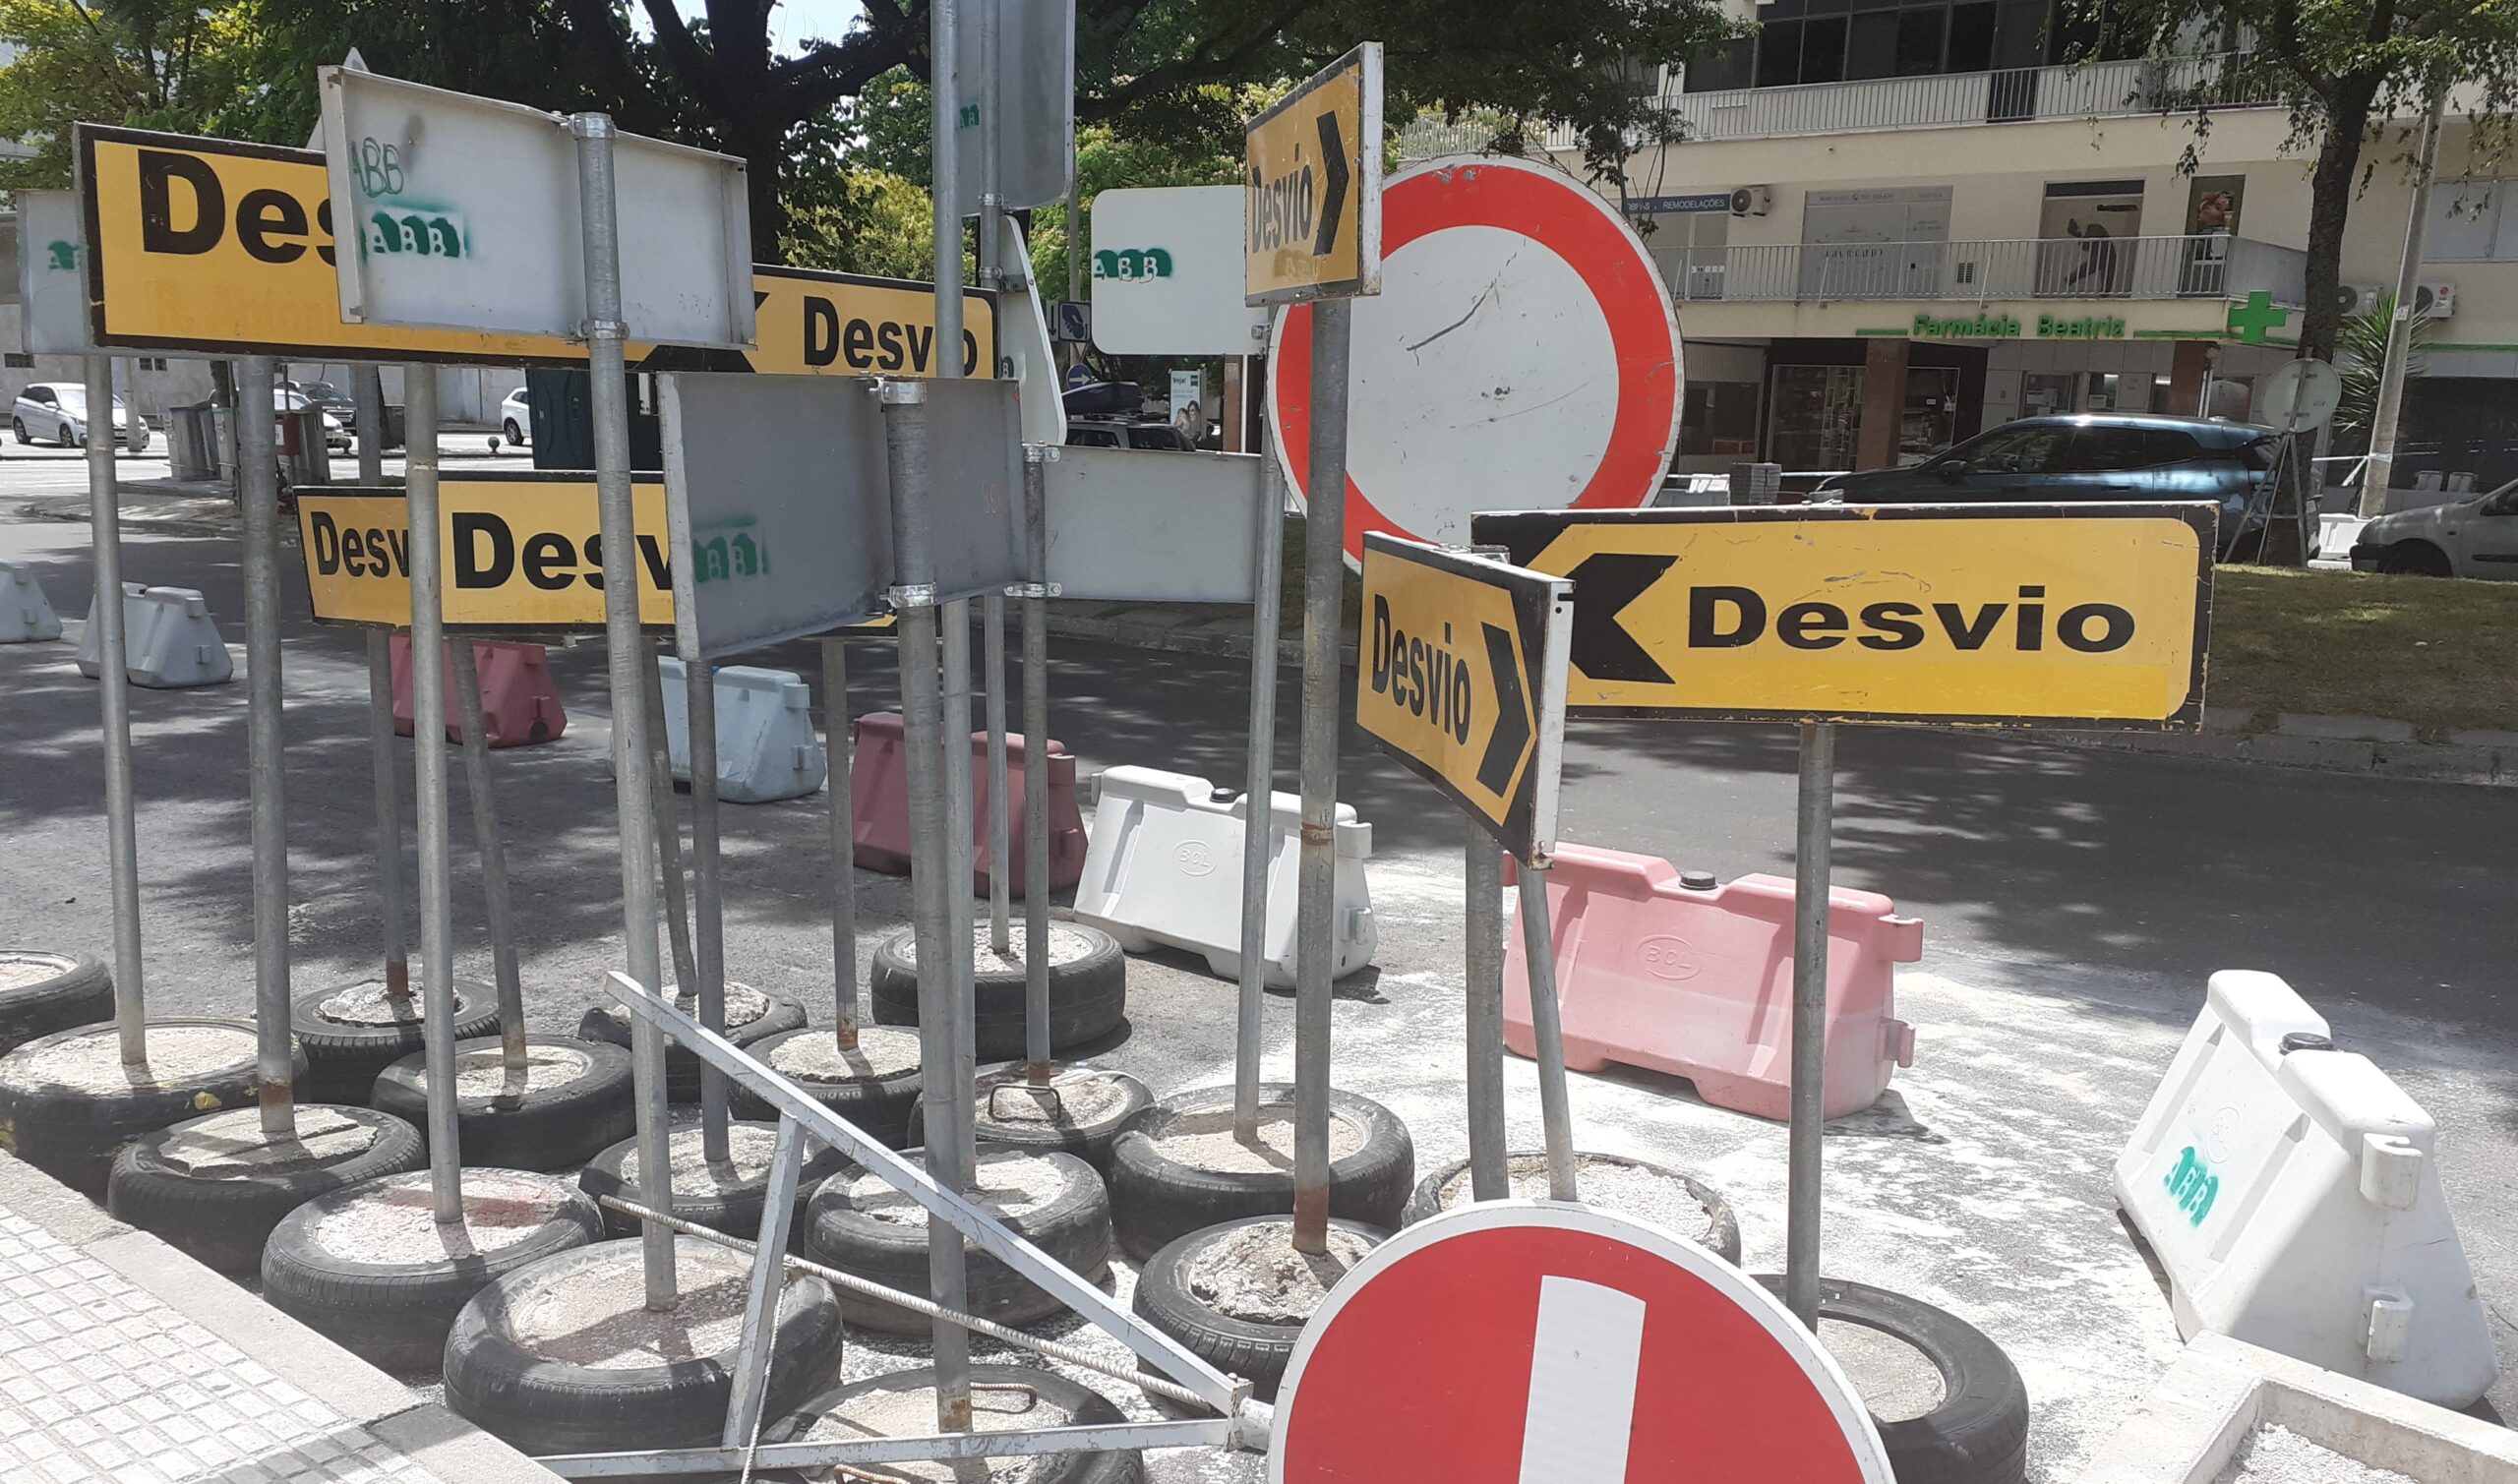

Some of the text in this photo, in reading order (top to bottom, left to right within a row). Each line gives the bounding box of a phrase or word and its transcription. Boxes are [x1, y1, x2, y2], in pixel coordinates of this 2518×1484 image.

[1252, 143, 1313, 254] Desvio
[1662, 199, 1725, 209] REMODELAÇÕES
[1093, 248, 1172, 279] ABB
[804, 295, 978, 377] Desvo
[1913, 313, 2126, 337] Farmácia Beatriz
[1689, 584, 2135, 653] Desvio
[1371, 593, 1471, 746] Desvio
